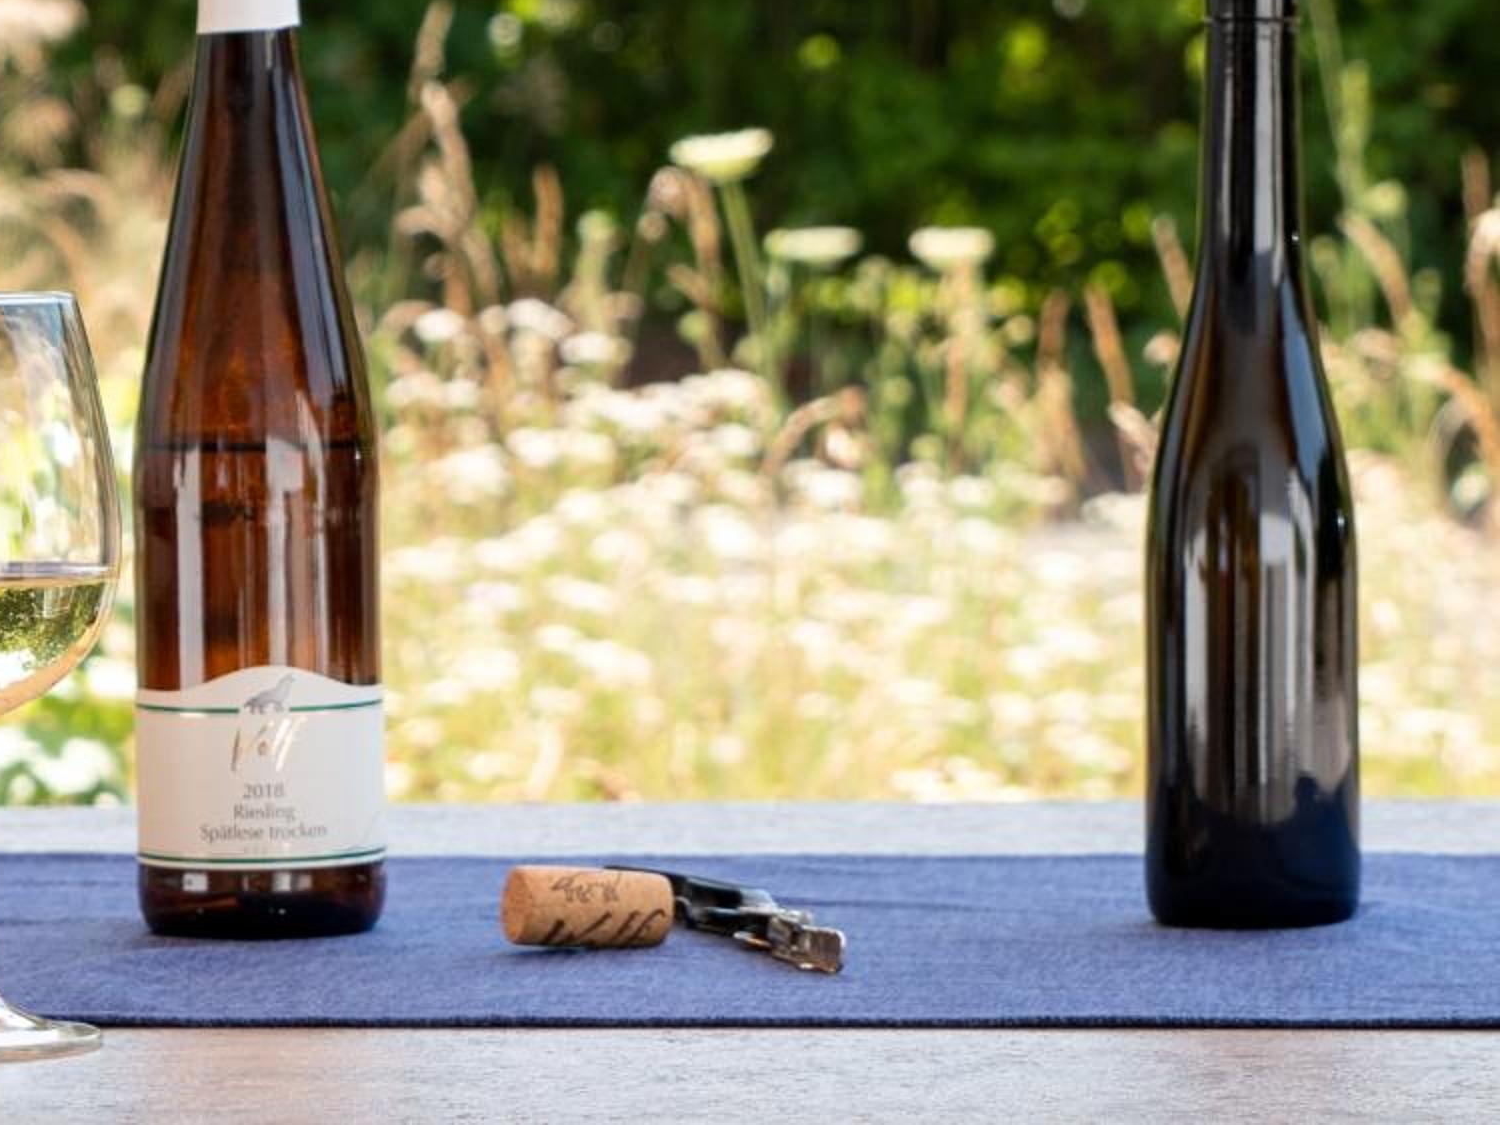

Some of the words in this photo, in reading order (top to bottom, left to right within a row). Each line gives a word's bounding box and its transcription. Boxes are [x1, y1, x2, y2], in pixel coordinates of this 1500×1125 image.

[242, 782, 285, 799] 2018
[233, 803, 296, 823] Riesling
[199, 824, 265, 844] Spätlese
[268, 822, 328, 840] trocken
